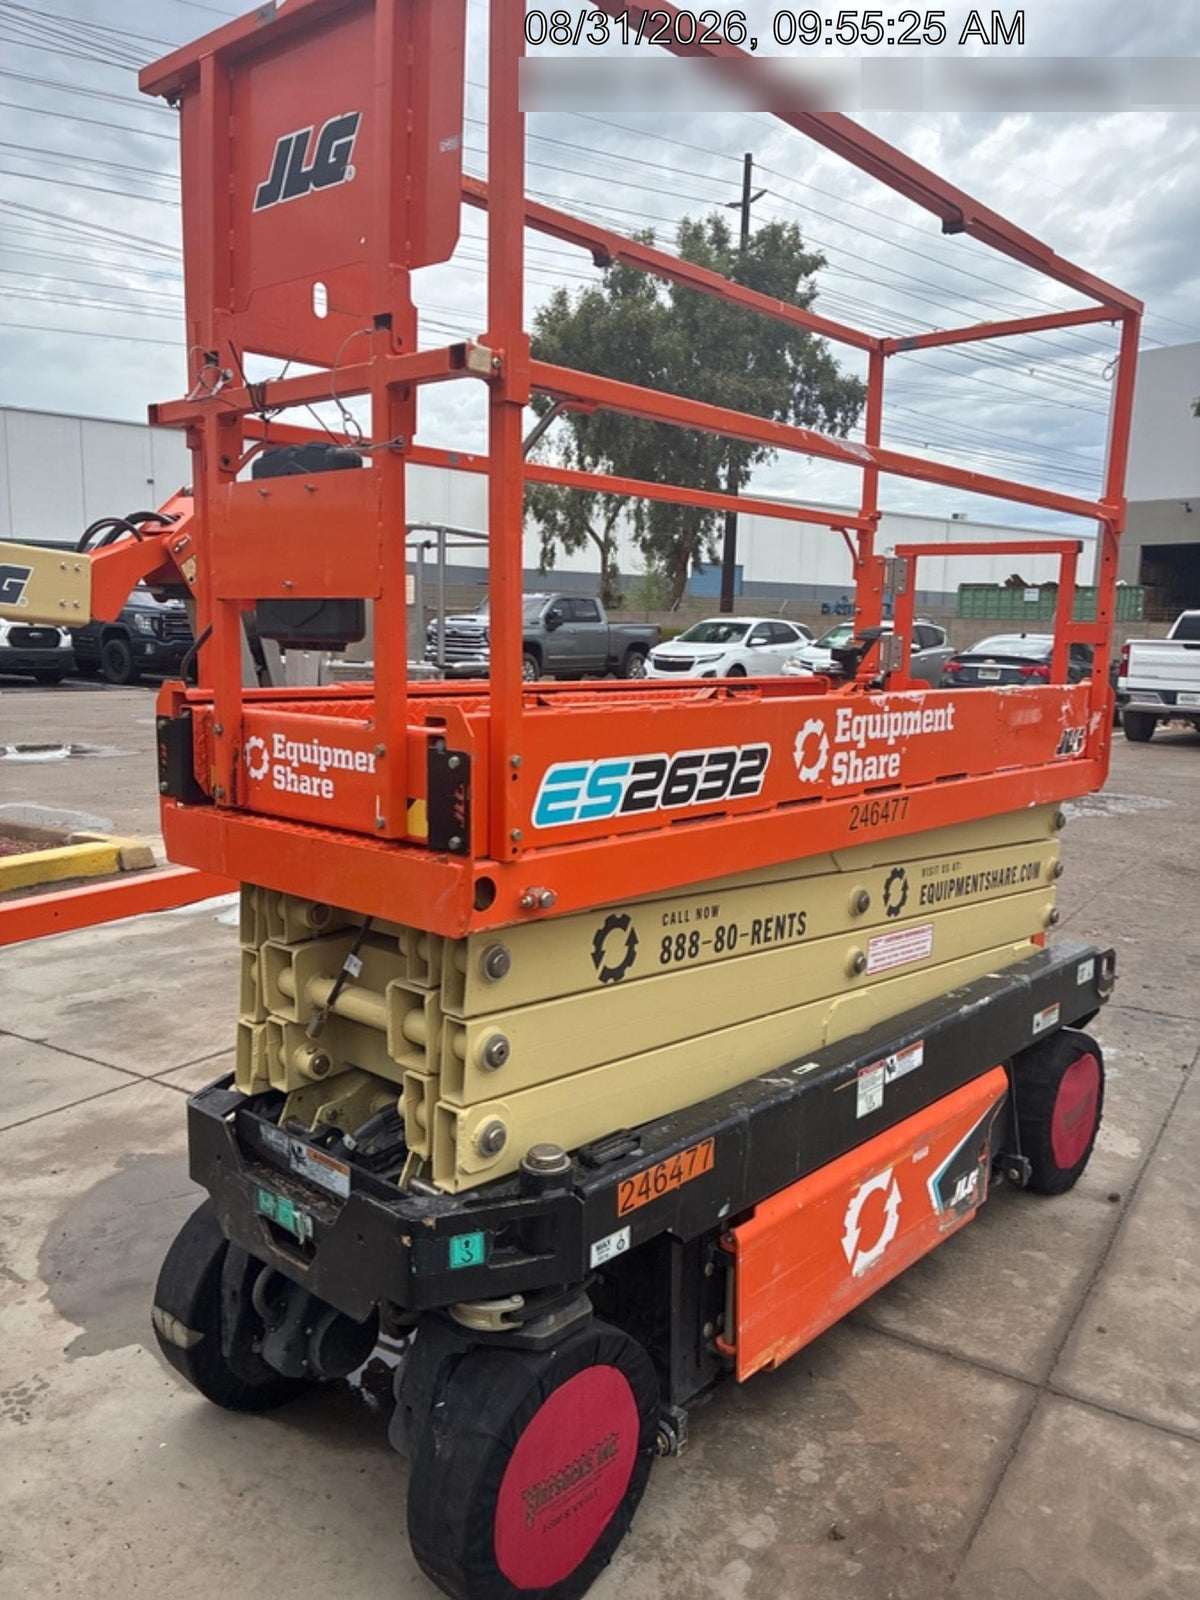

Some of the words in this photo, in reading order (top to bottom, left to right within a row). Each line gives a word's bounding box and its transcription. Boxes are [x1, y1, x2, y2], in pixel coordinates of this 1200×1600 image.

[252, 111, 362, 213] JLG
[834, 702, 955, 748] Equipment
[272, 765, 334, 799] Share
[532, 744, 771, 828] ES2632
[831, 751, 900, 786] Share
[849, 796, 910, 831] 246477
[919, 861, 1041, 906] EQUIPMENTSHARE.COM
[660, 910, 807, 964] 888-80-RENTS
[662, 909, 690, 926] CALL
[696, 905, 720, 920] NOW
[620, 1139, 712, 1213] 246477
